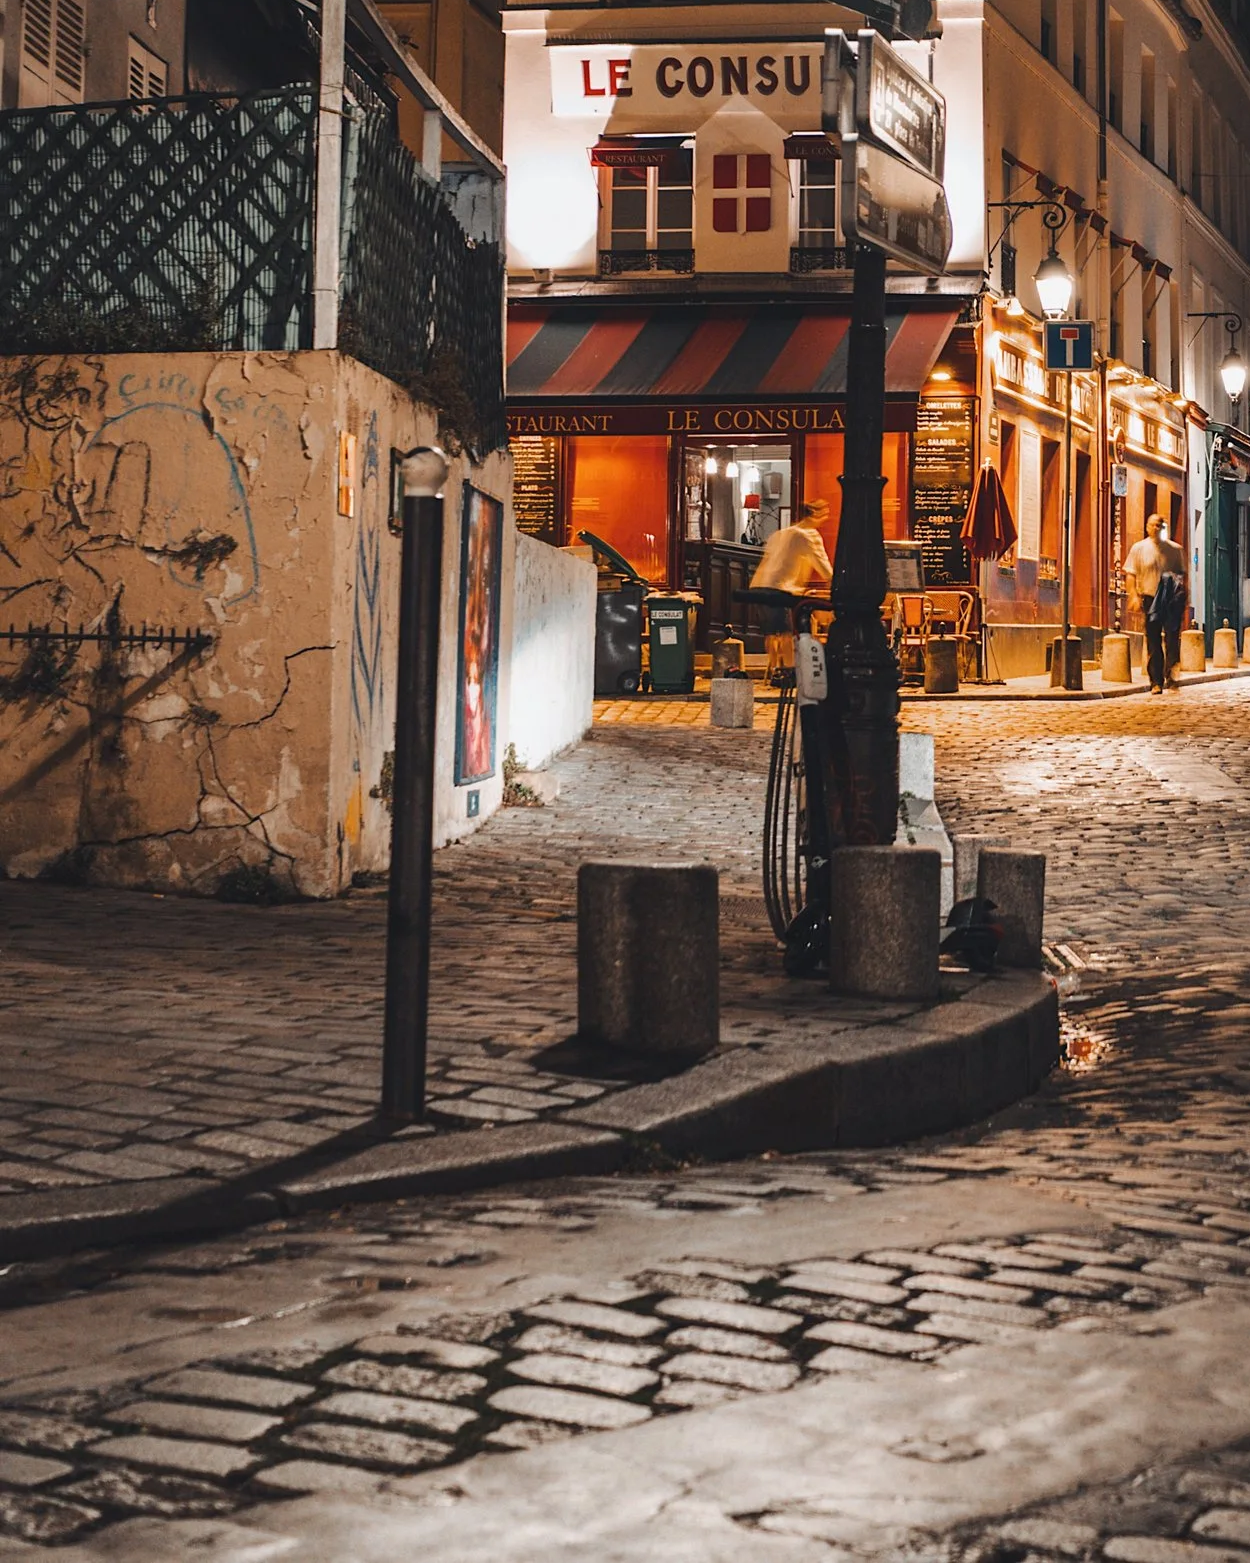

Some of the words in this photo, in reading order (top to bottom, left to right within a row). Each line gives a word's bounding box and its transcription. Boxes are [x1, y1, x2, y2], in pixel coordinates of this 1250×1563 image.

[580, 59, 633, 97] LE
[656, 55, 825, 98] CONSU
[605, 154, 665, 164] RESTAURANT
[795, 146, 808, 156] LE
[811, 145, 841, 155] CONS
[505, 414, 613, 432] STAURANT
[667, 410, 701, 431] LE
[714, 409, 846, 431] CONSULA
